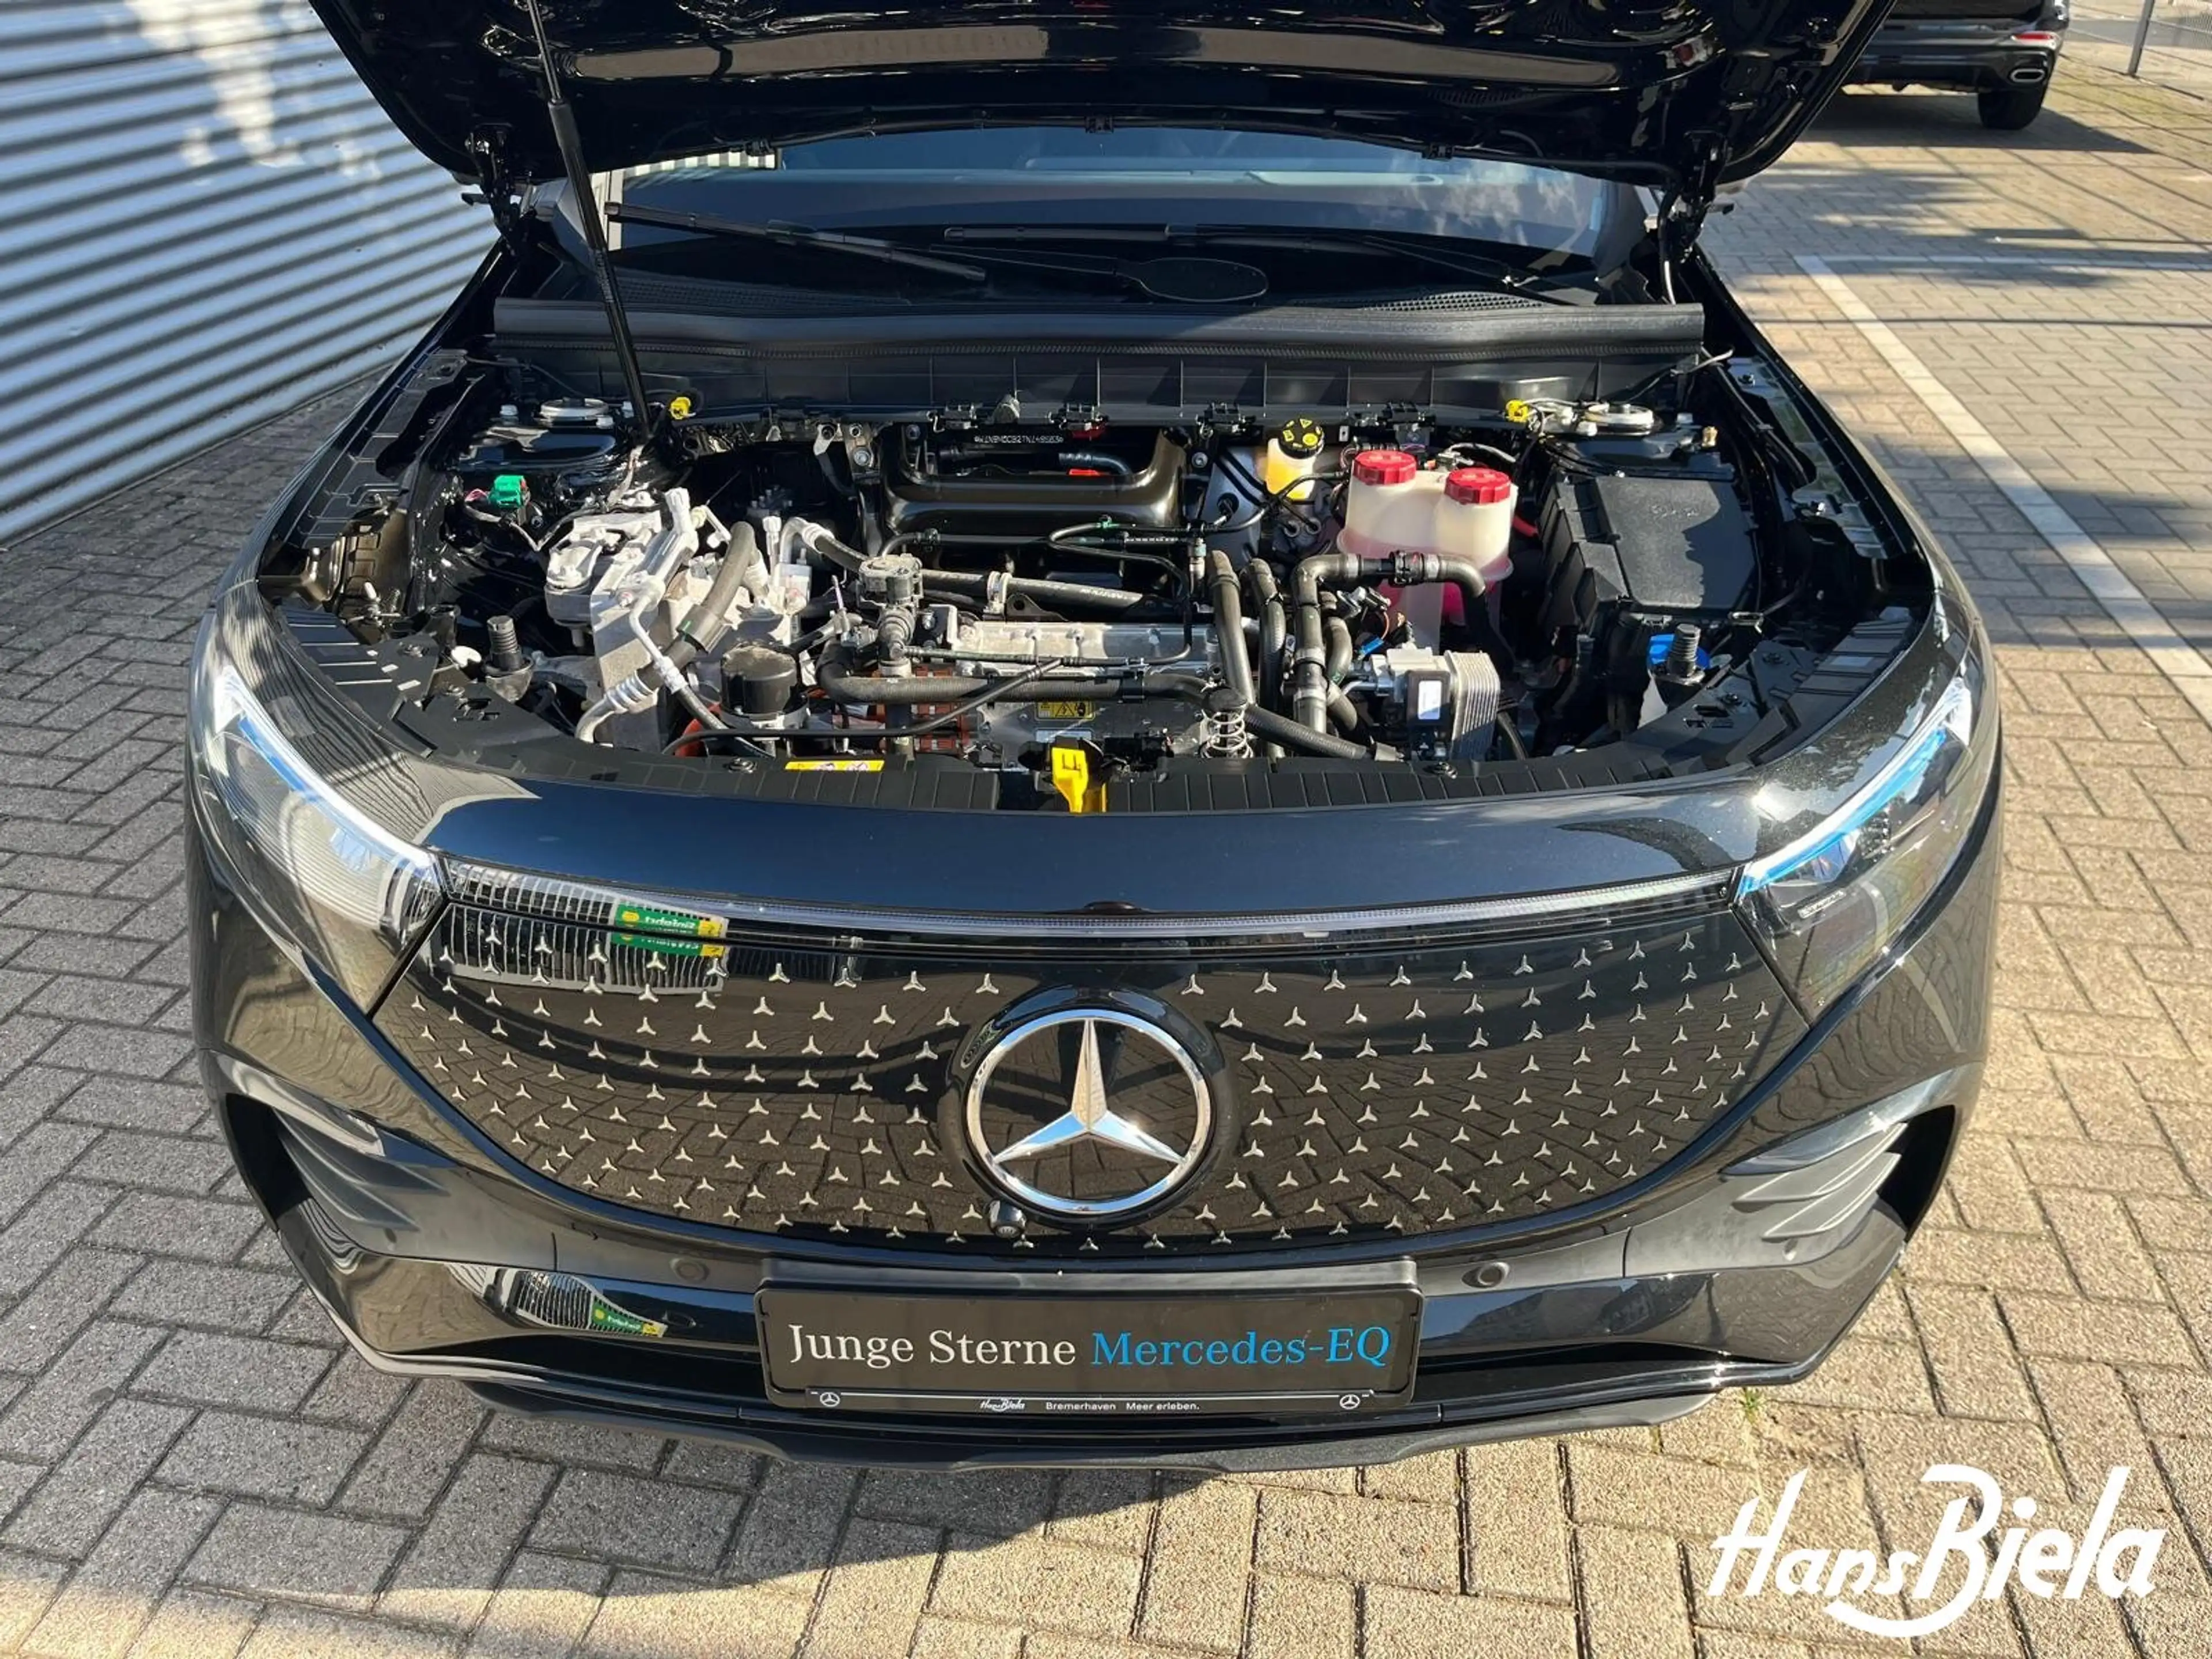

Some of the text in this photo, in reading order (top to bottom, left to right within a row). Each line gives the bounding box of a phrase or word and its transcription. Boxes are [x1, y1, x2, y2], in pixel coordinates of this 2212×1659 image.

[789, 1324, 1391, 1369] Junge Sterne Mercedes-EQ
[1046, 1402, 1116, 1410] Bremerhaven
[1126, 1402, 1153, 1411] Meer
[1156, 1402, 1200, 1410] erleben.
